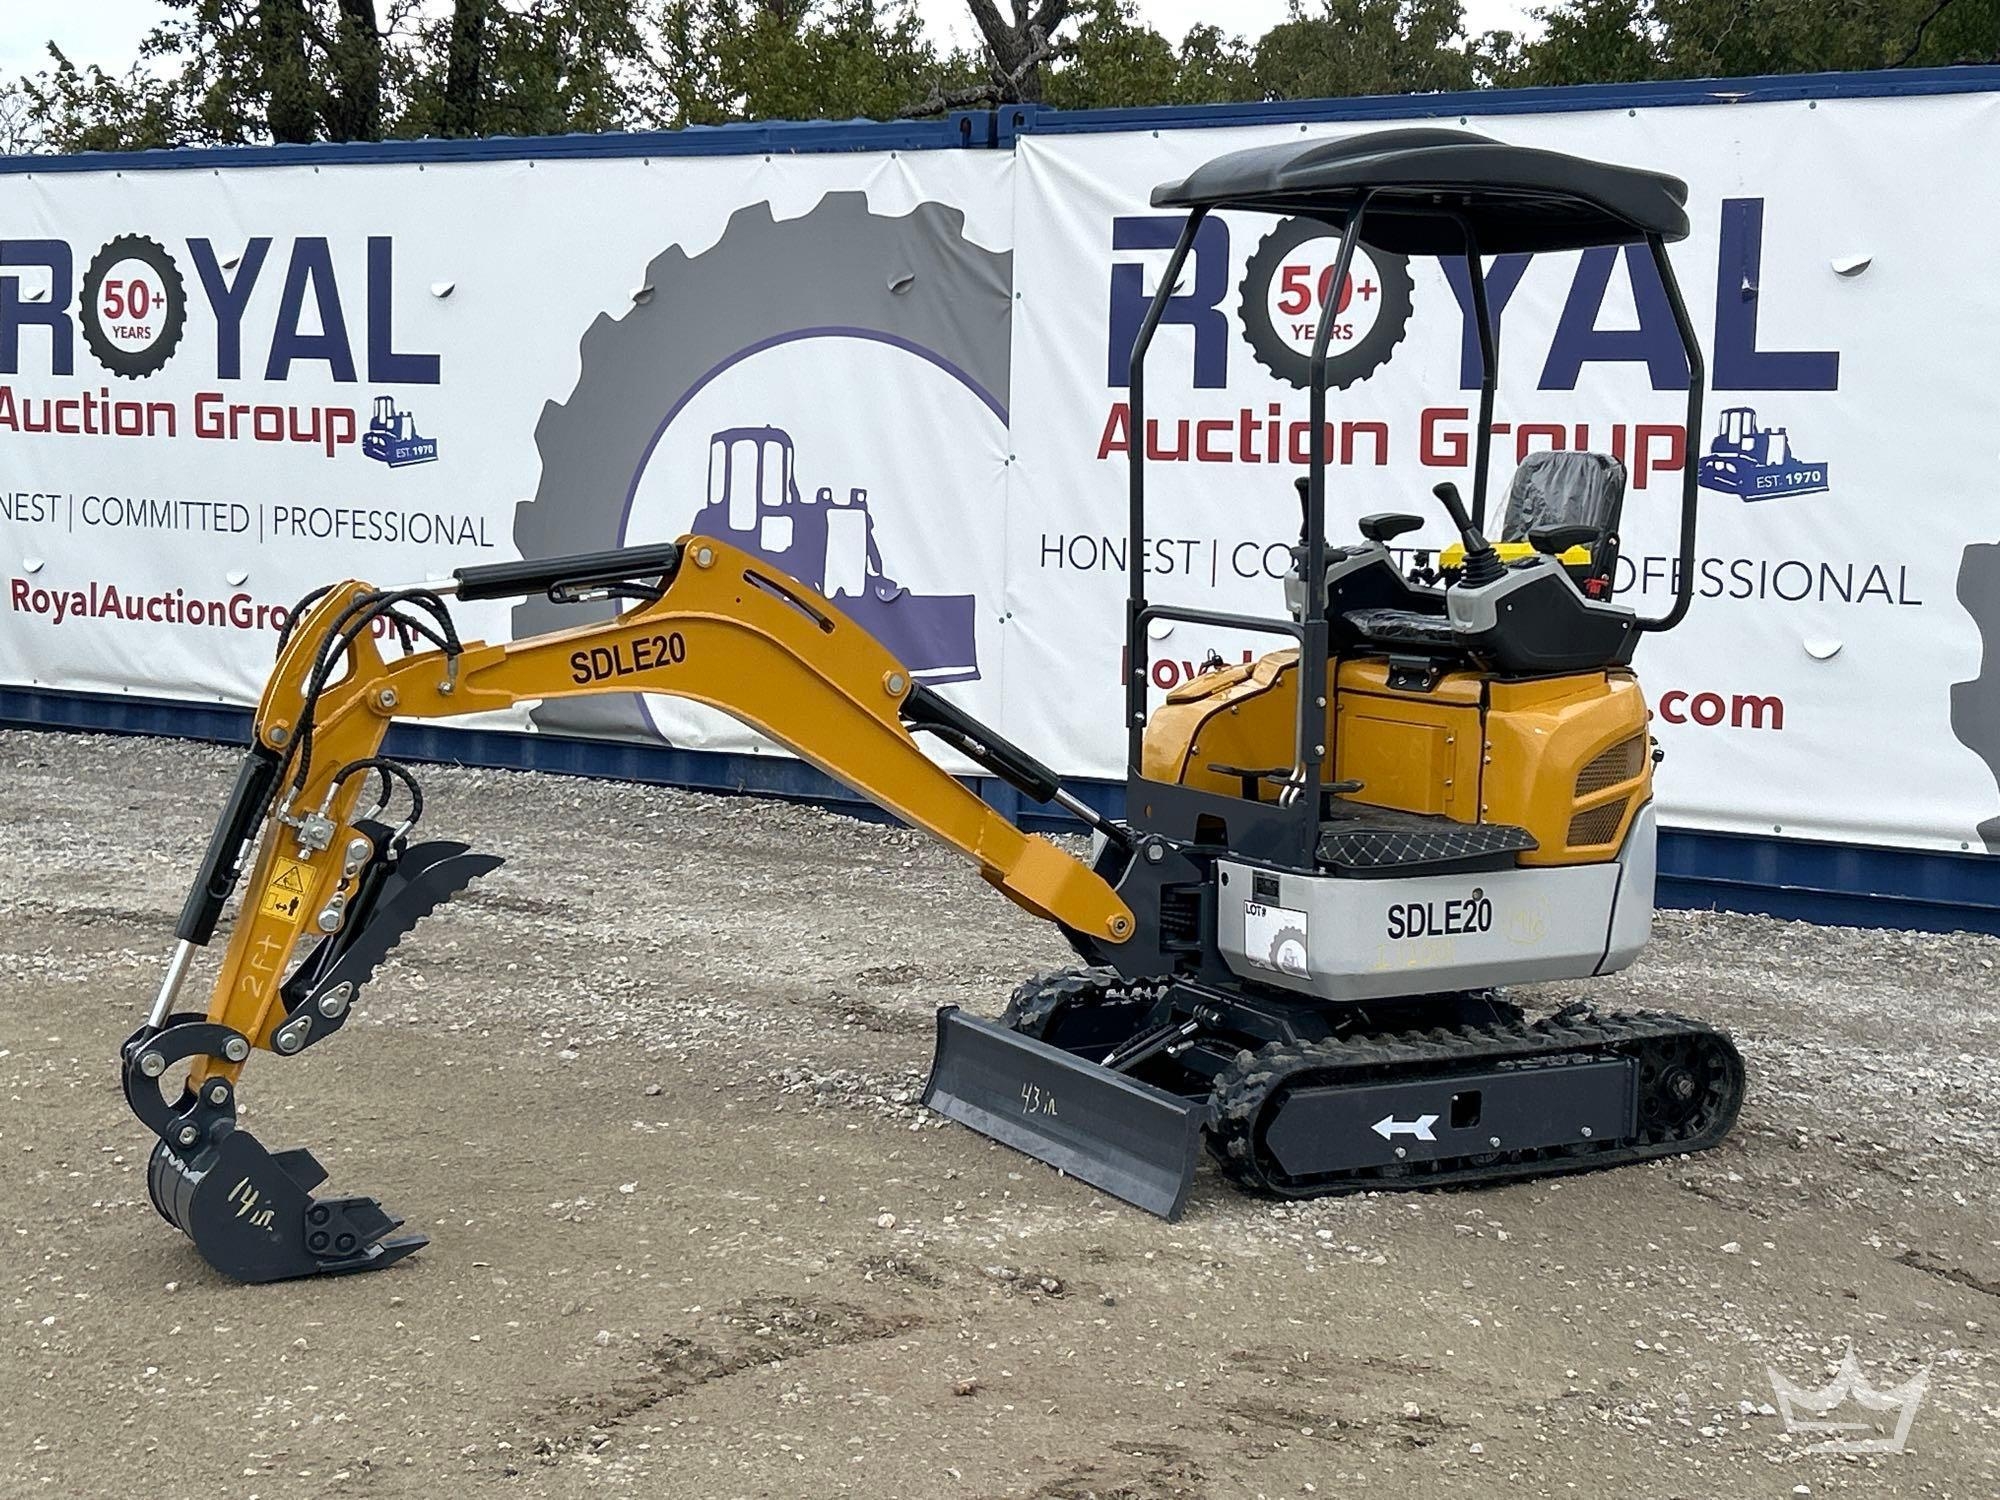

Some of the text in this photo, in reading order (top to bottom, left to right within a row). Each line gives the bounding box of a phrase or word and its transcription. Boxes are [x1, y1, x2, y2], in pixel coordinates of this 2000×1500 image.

[103, 279, 165, 319] 50+
[112, 326, 151, 340] YEARS
[1291, 324, 1354, 340] YERS
[0, 386, 356, 458] Auction Group
[1097, 402, 1389, 466] Auction
[412, 445, 434, 456] 1970
[1785, 471, 1821, 485] 1970
[82, 496, 249, 533] COMMITTED
[274, 506, 494, 548] PROFESSIONAL
[570, 632, 686, 684] SDLE20
[1387, 897, 1493, 940] SDLE20
[1021, 1082, 1040, 1115] 43
